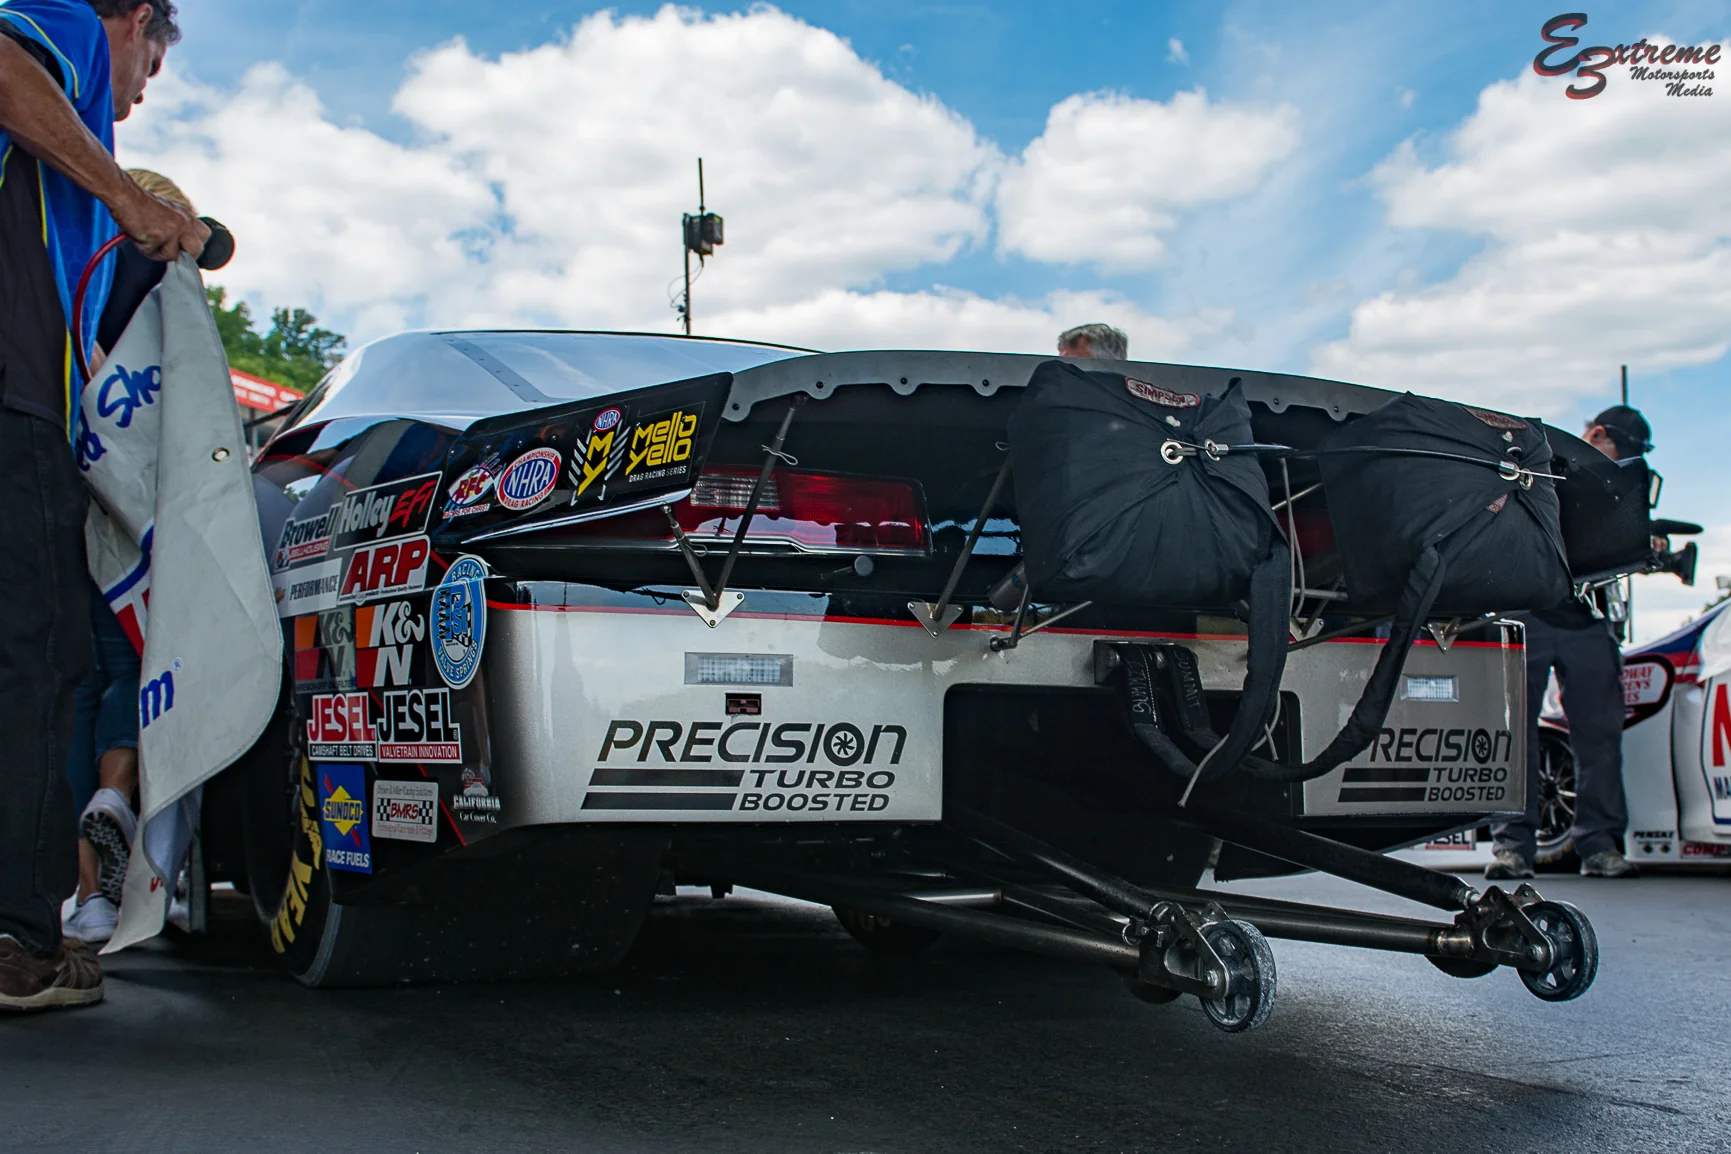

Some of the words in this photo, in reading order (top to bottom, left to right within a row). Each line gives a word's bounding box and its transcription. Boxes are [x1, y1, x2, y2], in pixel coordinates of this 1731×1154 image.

[1135, 384, 1186, 403] SIMPSON
[596, 411, 618, 428] NHRA
[514, 451, 555, 467] CHAMPIONSHIP
[507, 461, 551, 497] NHRA
[629, 473, 644, 482] DRAG
[645, 469, 666, 479] RACING
[666, 465, 687, 476] SERIES
[338, 491, 395, 538] Holley
[389, 479, 437, 528] EFI
[504, 496, 518, 508] DRAG
[521, 493, 544, 507] RACING
[280, 507, 337, 548] Browell
[341, 539, 428, 595] ARP
[451, 563, 480, 581] RACING
[290, 575, 339, 600] PERFORMANCE
[438, 646, 454, 679] VALVE
[455, 640, 478, 679] SPRINGS
[308, 695, 371, 742] JESEL
[378, 691, 453, 742] JESEL
[311, 745, 338, 756] CAMSHAFT
[339, 745, 353, 757] BELT
[353, 745, 373, 757] DRIVES
[381, 746, 417, 758] VALVETRAIN
[418, 746, 457, 758] INNOVATION
[597, 720, 908, 766] PRECISION
[1366, 728, 1512, 764] RECISION
[750, 769, 896, 789] TURBO
[1430, 767, 1507, 783] TURBO
[453, 794, 501, 809] CALIFORNIA
[739, 793, 890, 812] BOOSTED
[1428, 786, 1505, 801] BOOSTED
[324, 801, 361, 820] SUNOCO
[390, 802, 419, 820] BMRS
[460, 811, 469, 821] Car
[470, 811, 485, 822] Cover
[326, 849, 345, 866] RACE
[346, 851, 370, 868] FUELS
